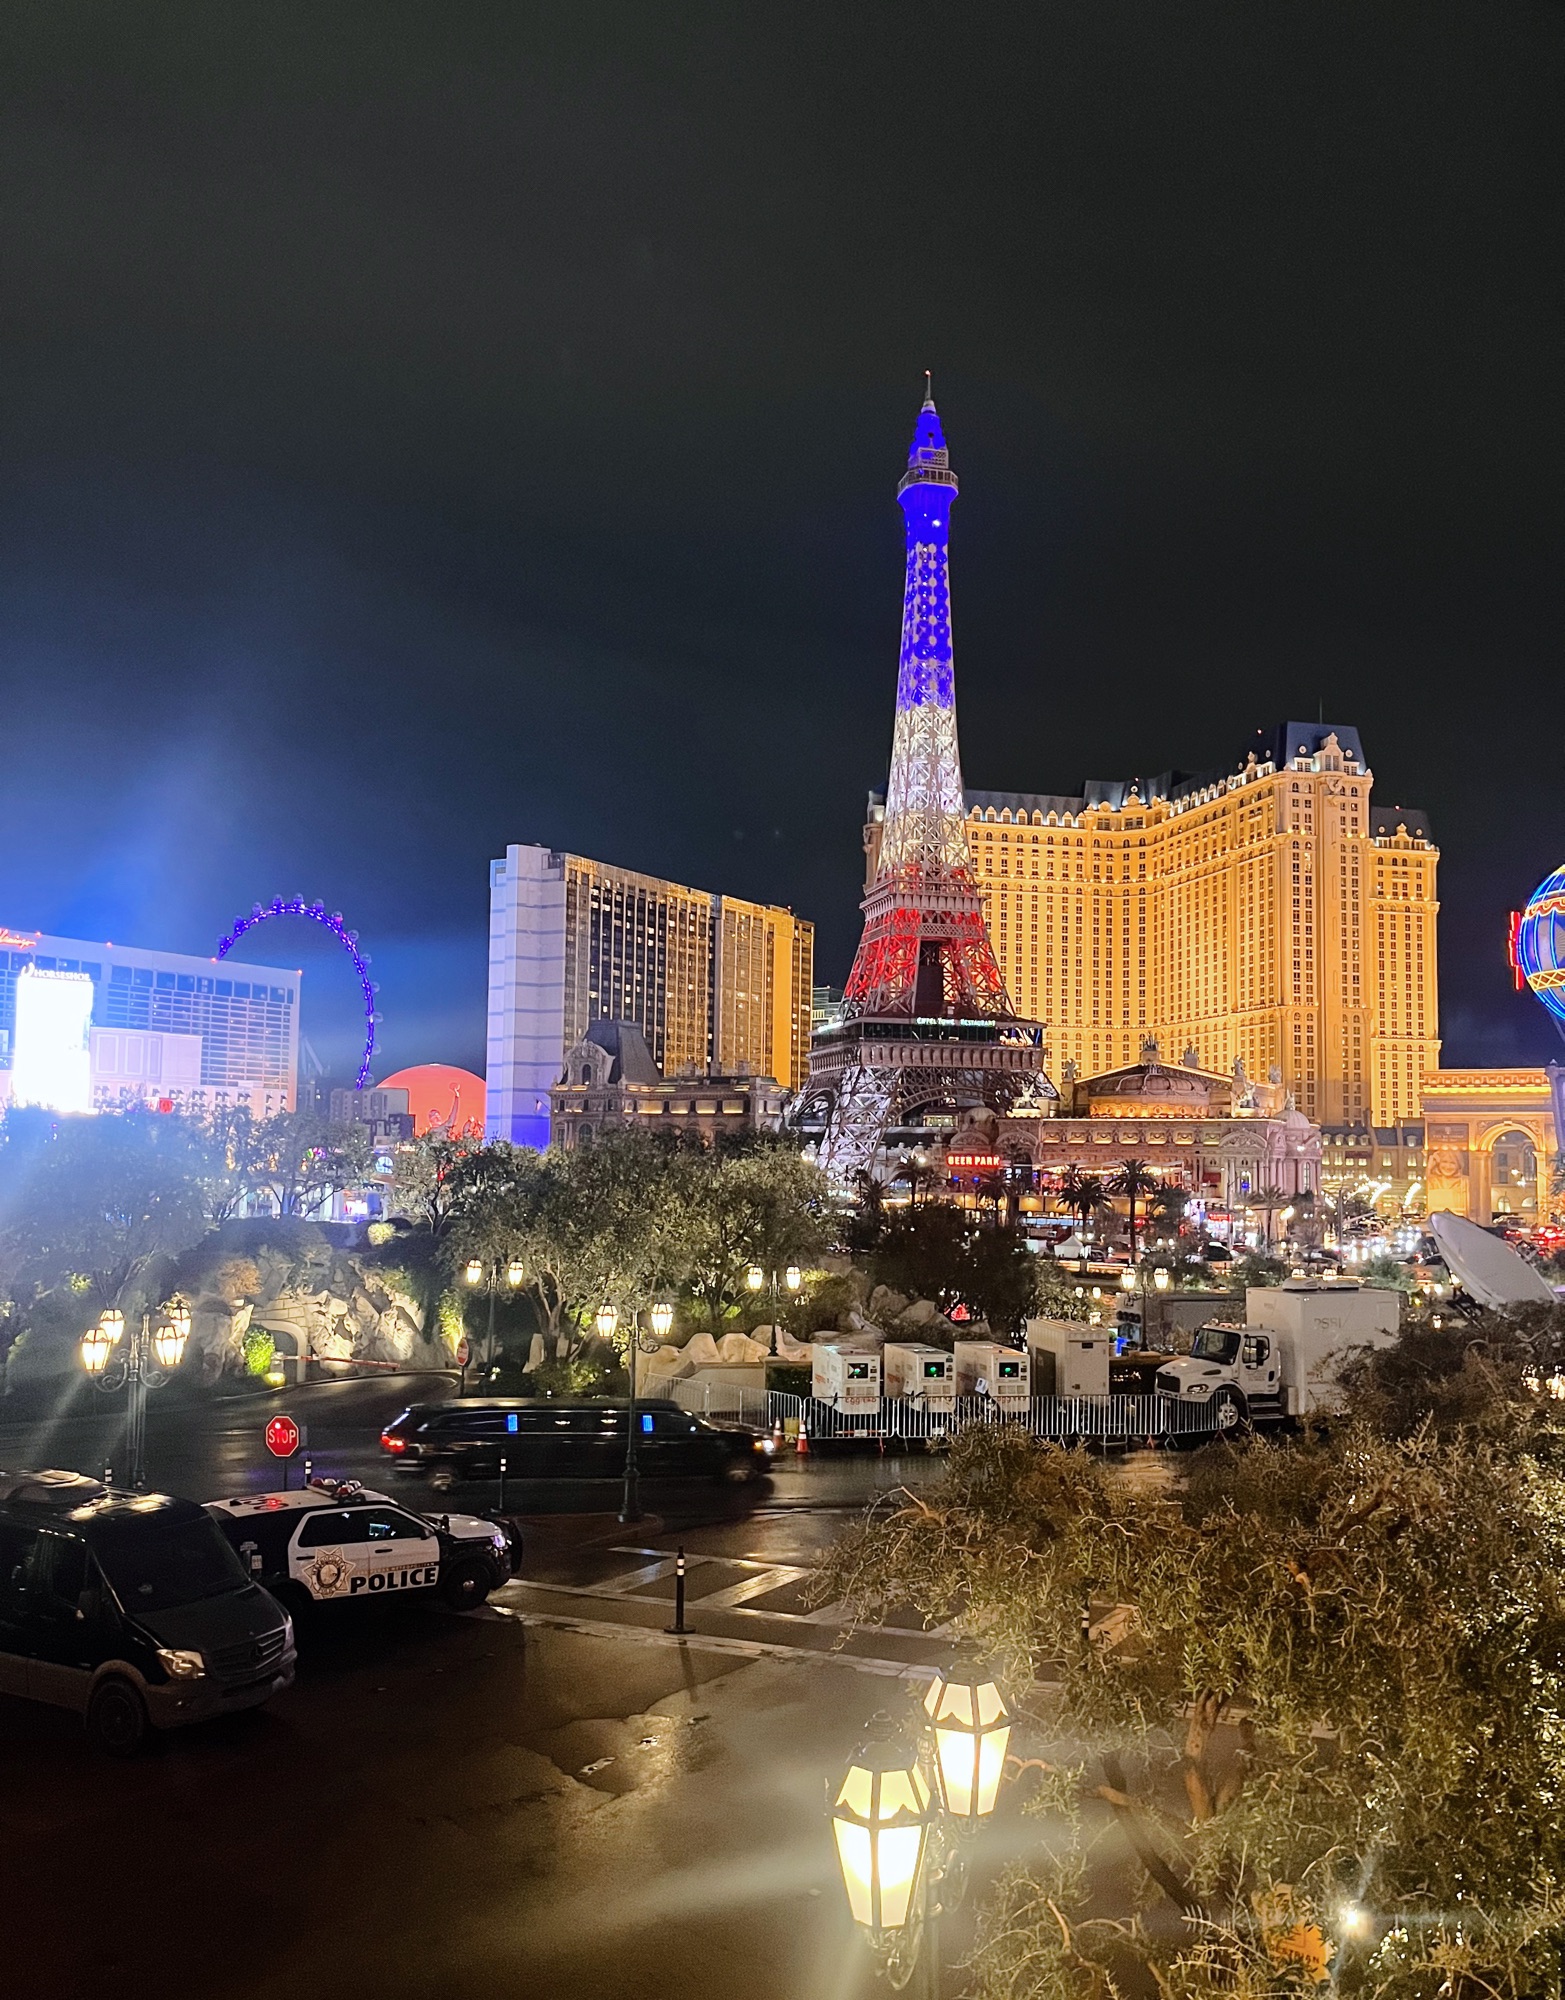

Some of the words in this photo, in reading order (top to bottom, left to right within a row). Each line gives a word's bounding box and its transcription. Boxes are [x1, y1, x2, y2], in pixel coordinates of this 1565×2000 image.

[34, 968, 91, 982] HORSESHOE
[947, 1156, 973, 1166] BEER
[974, 1155, 1000, 1166] PARK
[268, 1428, 296, 1444] STOP
[350, 1567, 437, 1594] POLICE
